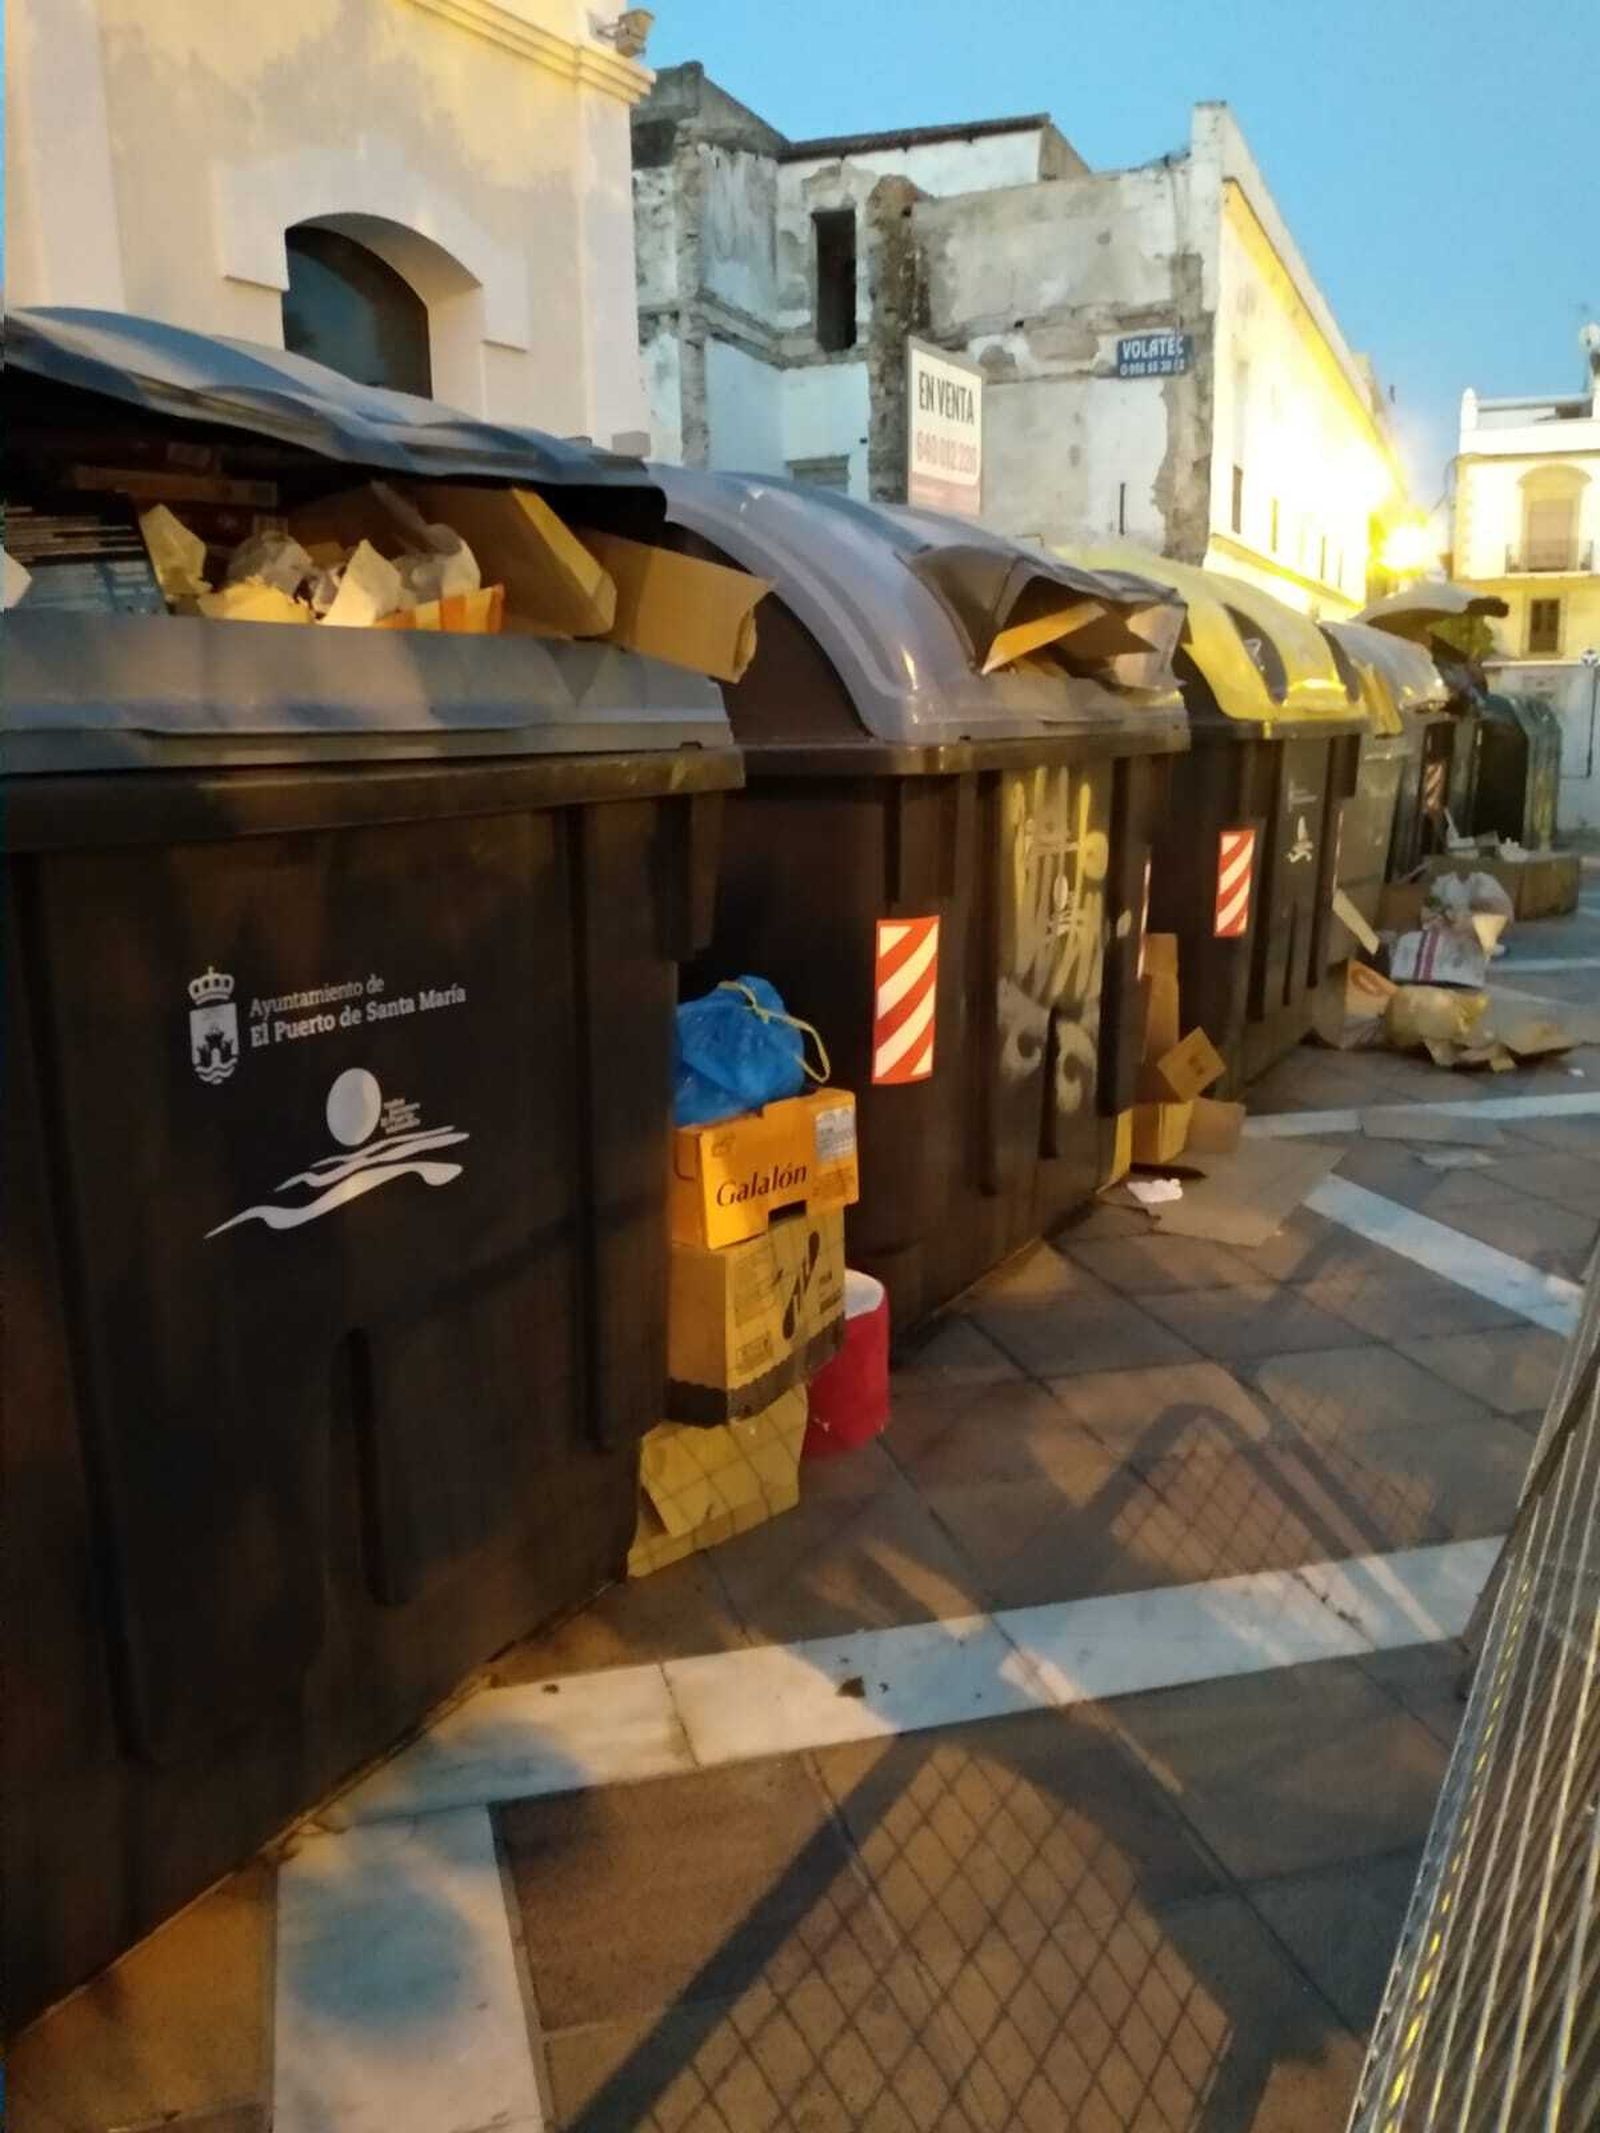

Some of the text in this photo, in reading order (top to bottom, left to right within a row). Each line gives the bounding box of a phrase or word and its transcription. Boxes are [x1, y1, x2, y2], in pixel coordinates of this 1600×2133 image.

[918, 370, 974, 425] EN VENTA
[250, 973, 385, 1021] Ayuntamiento de
[250, 982, 467, 1048] El Puerto de Santa María
[717, 1162, 807, 1207] Galalón
